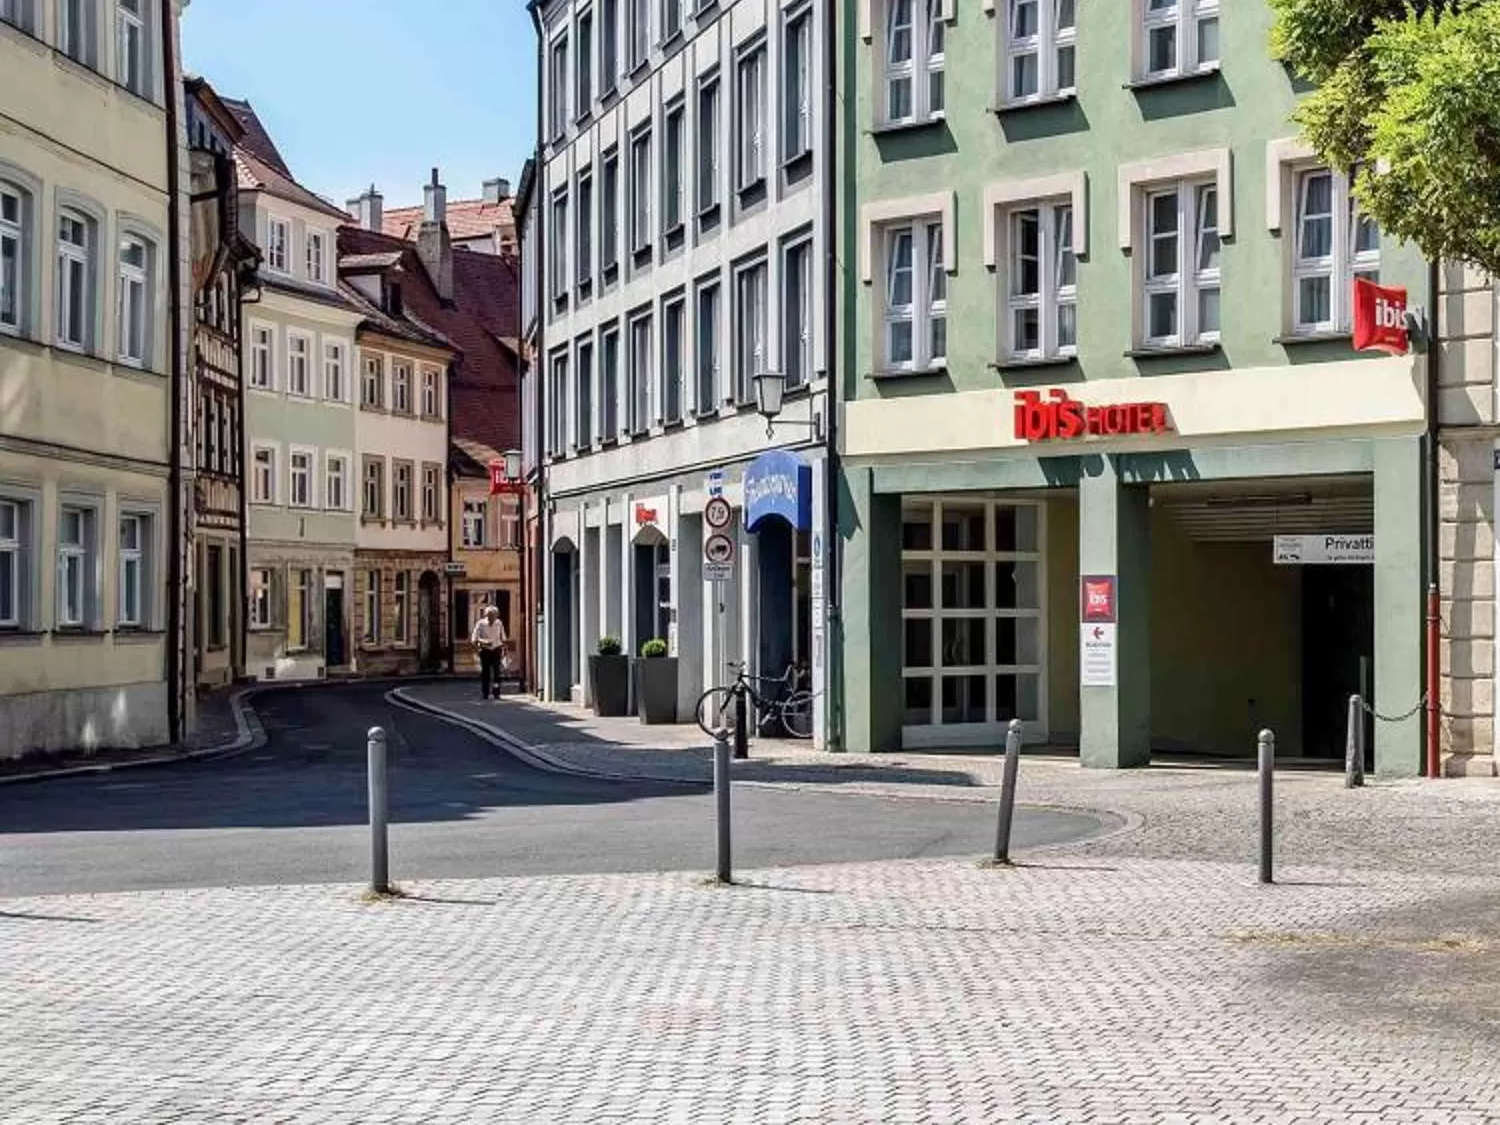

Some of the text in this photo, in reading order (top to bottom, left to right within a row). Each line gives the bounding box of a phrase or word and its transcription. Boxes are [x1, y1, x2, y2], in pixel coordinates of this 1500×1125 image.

[1374, 298, 1409, 331] ibis
[1014, 388, 1174, 441] ibis HOTEL
